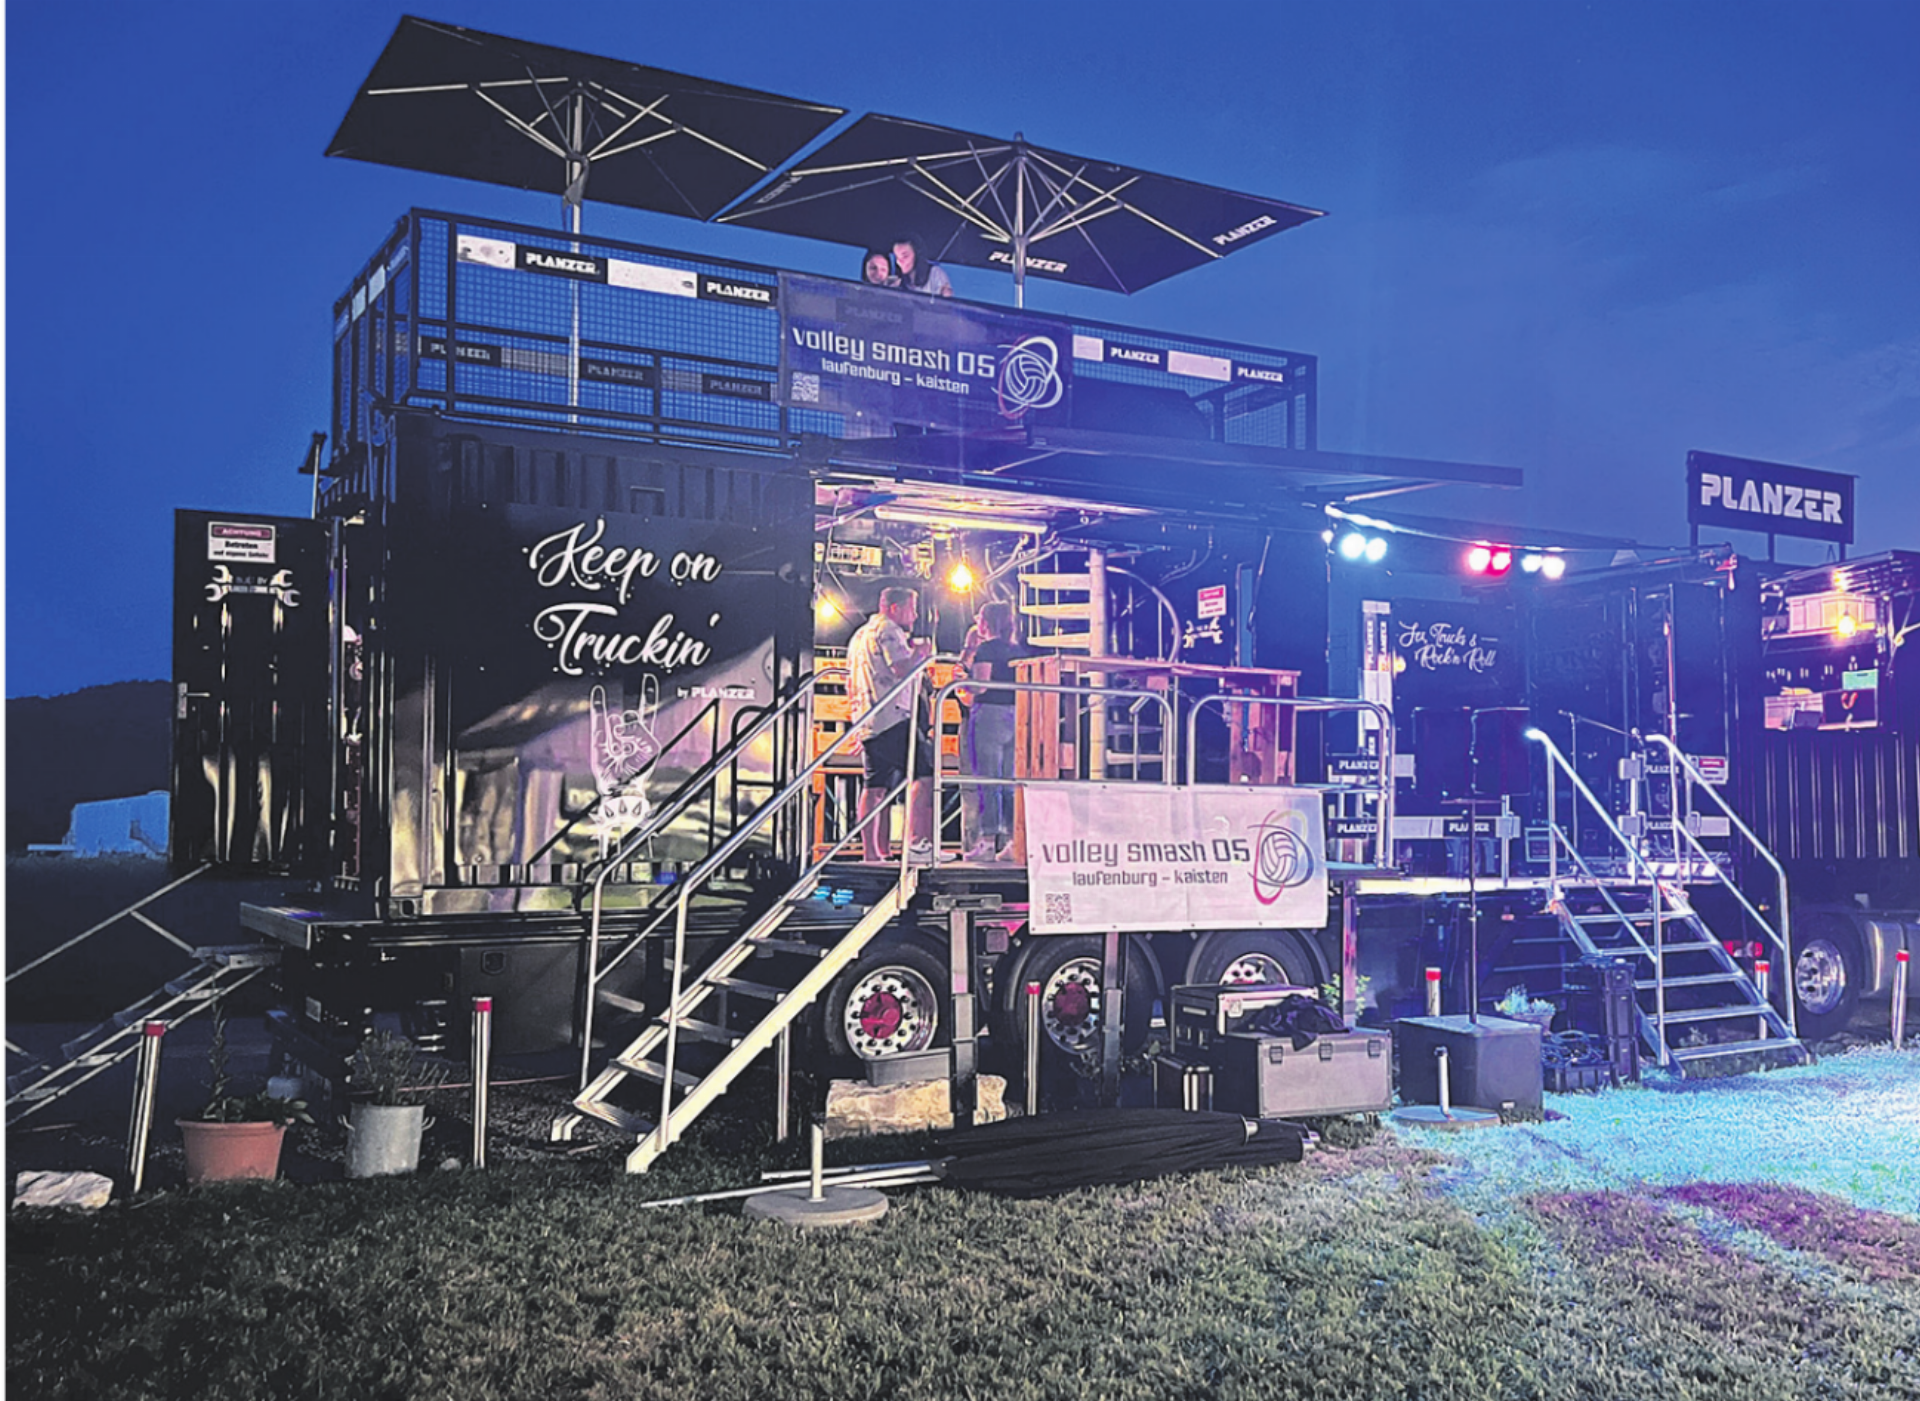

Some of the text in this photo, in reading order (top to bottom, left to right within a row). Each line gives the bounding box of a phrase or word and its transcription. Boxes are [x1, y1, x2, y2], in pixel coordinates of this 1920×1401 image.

[1212, 215, 1277, 245] PLANZER
[526, 252, 596, 275] PLANZER
[988, 251, 1068, 273] PLNZER
[707, 281, 771, 302] PLANZER
[792, 327, 865, 361] volley
[872, 341, 950, 372] smash
[1110, 347, 1160, 364] PLANZER
[587, 363, 644, 381] PLANZER
[821, 358, 901, 386] laufenburg
[916, 373, 970, 395] kaisten
[1237, 367, 1284, 383] PLANZER
[709, 379, 763, 396] PLANZER
[1701, 472, 1844, 525] PLANZER
[529, 518, 722, 605] Keep on
[533, 602, 721, 676] Truckin'
[1429, 622, 1467, 648] Trucks
[1463, 647, 1498, 674] Roll
[677, 686, 755, 700] by PLANZER
[1449, 822, 1490, 832] PLAZER
[1042, 839, 1118, 867] volley
[1127, 840, 1207, 863] smash
[1072, 870, 1158, 887] laufenburg
[1174, 869, 1229, 884] kaisten
